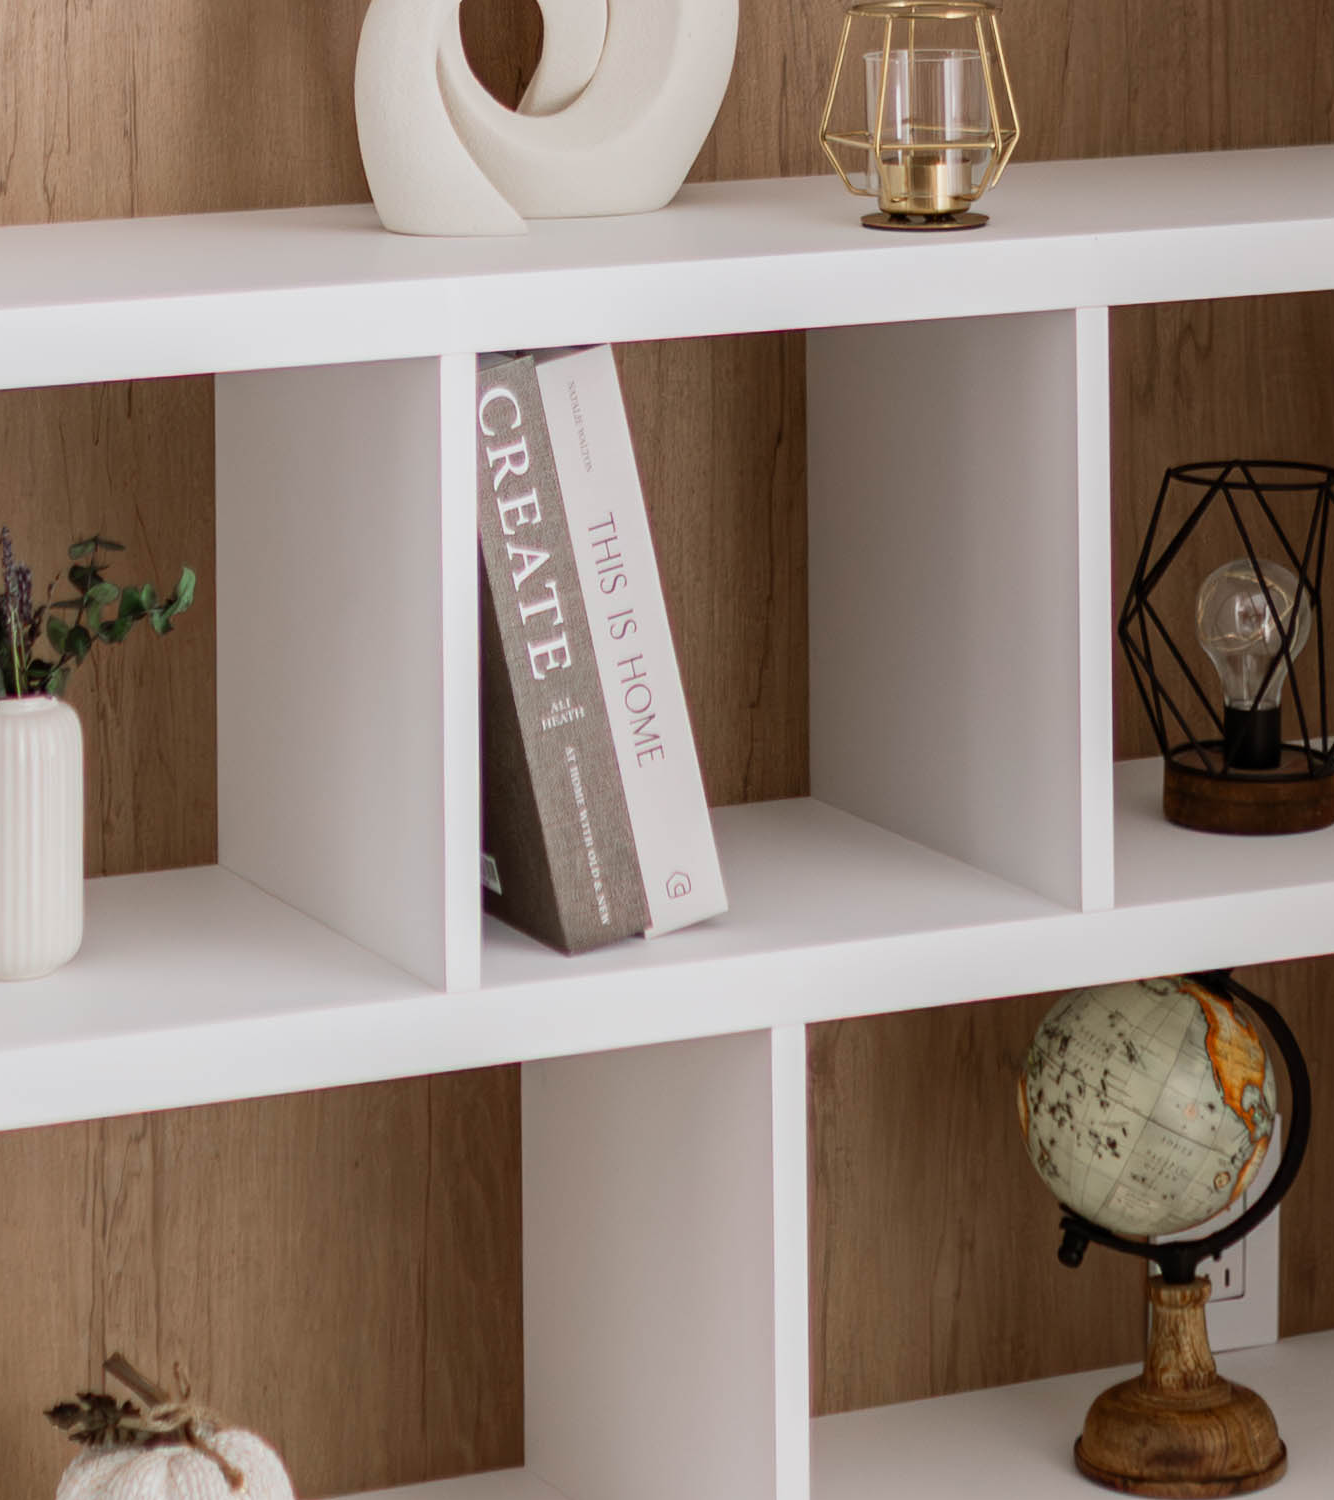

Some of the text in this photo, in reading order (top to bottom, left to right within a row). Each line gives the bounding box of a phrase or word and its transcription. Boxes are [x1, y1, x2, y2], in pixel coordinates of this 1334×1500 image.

[478, 387, 573, 682] CREATE
[587, 511, 665, 769] THIS IS HOME
[541, 706, 585, 731] HEATH
[565, 746, 575, 762] AT
[569, 766, 585, 807] HOME
[579, 809, 594, 847] WITH
[587, 851, 600, 879] OLD
[597, 895, 609, 925] NEW
